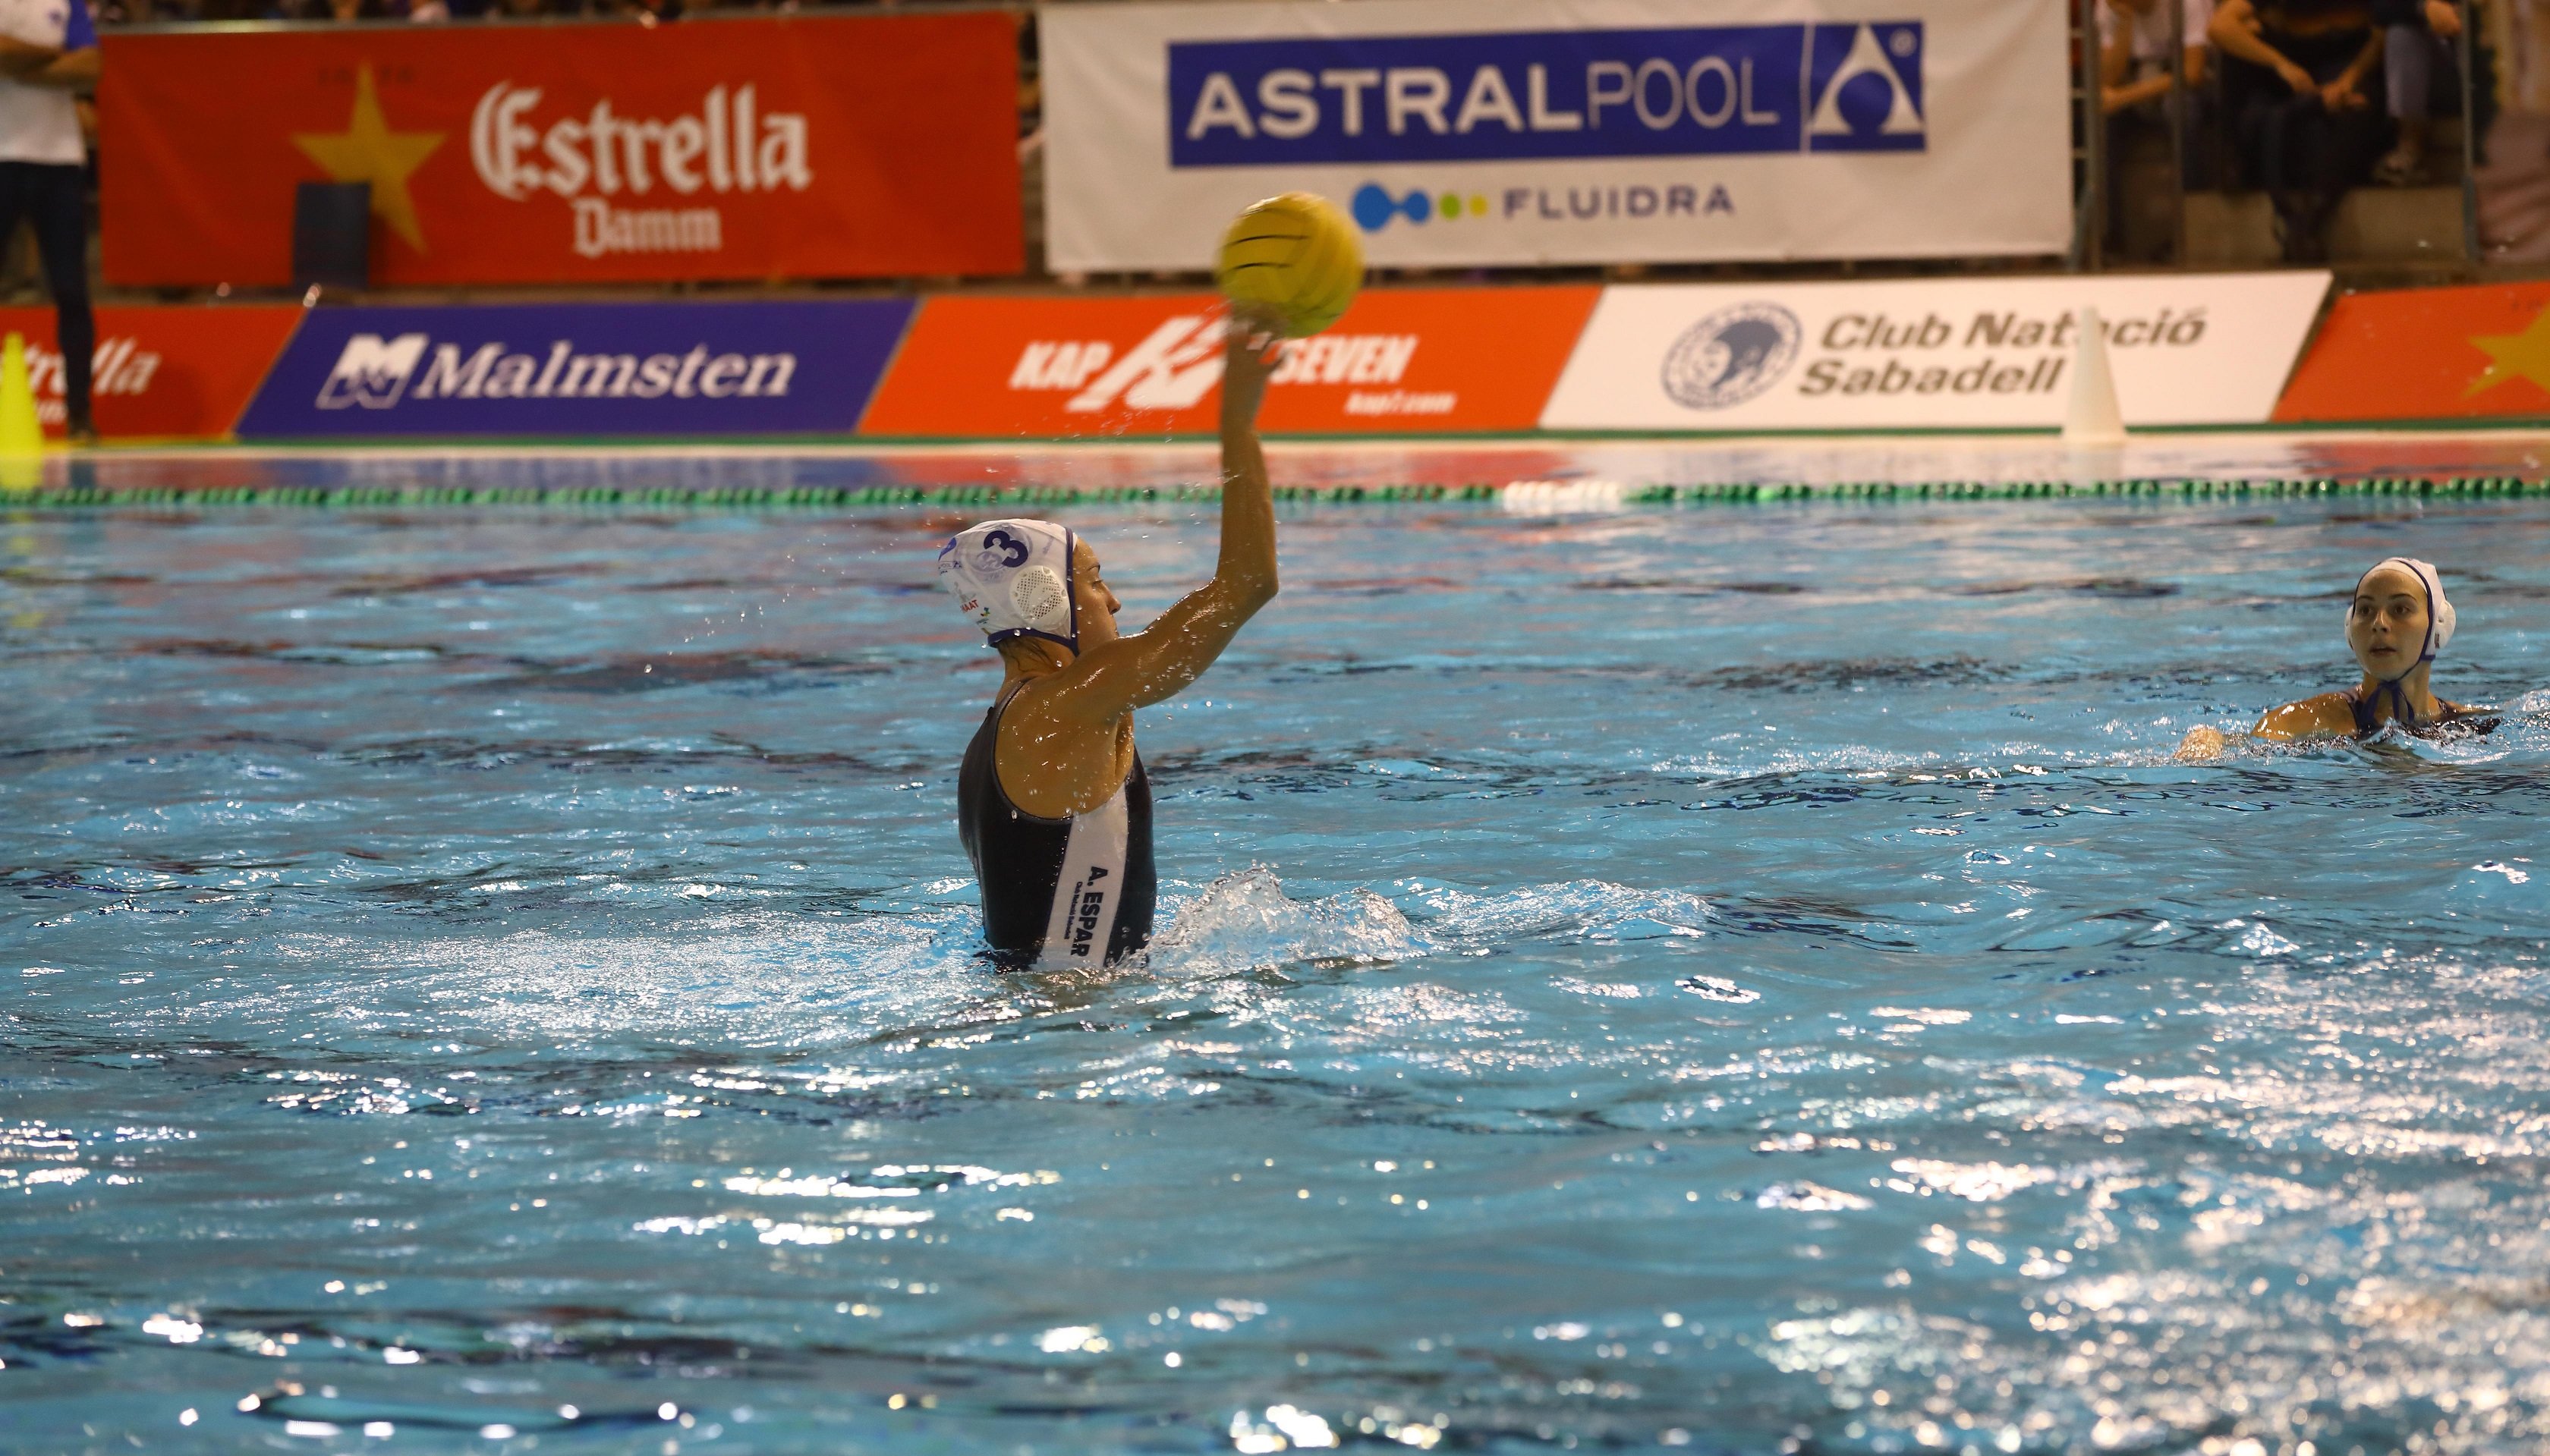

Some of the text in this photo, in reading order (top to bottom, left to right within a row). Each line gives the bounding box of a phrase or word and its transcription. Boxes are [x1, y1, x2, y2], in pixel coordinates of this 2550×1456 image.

[1186, 55, 1780, 140] ASTRALPOOL
[470, 80, 812, 201] Estrella
[571, 196, 723, 259] Damm
[1503, 184, 1736, 220] FLUIDRA
[1821, 303, 2207, 350] Club Natció
[411, 339, 798, 400] Malmsten
[1008, 341, 1113, 390] KAP
[1268, 335, 1418, 384] SEVEN
[1798, 349, 2067, 396] Sabadell
[984, 530, 1028, 568] 3
[1070, 866, 1108, 958] A. ESPAR
